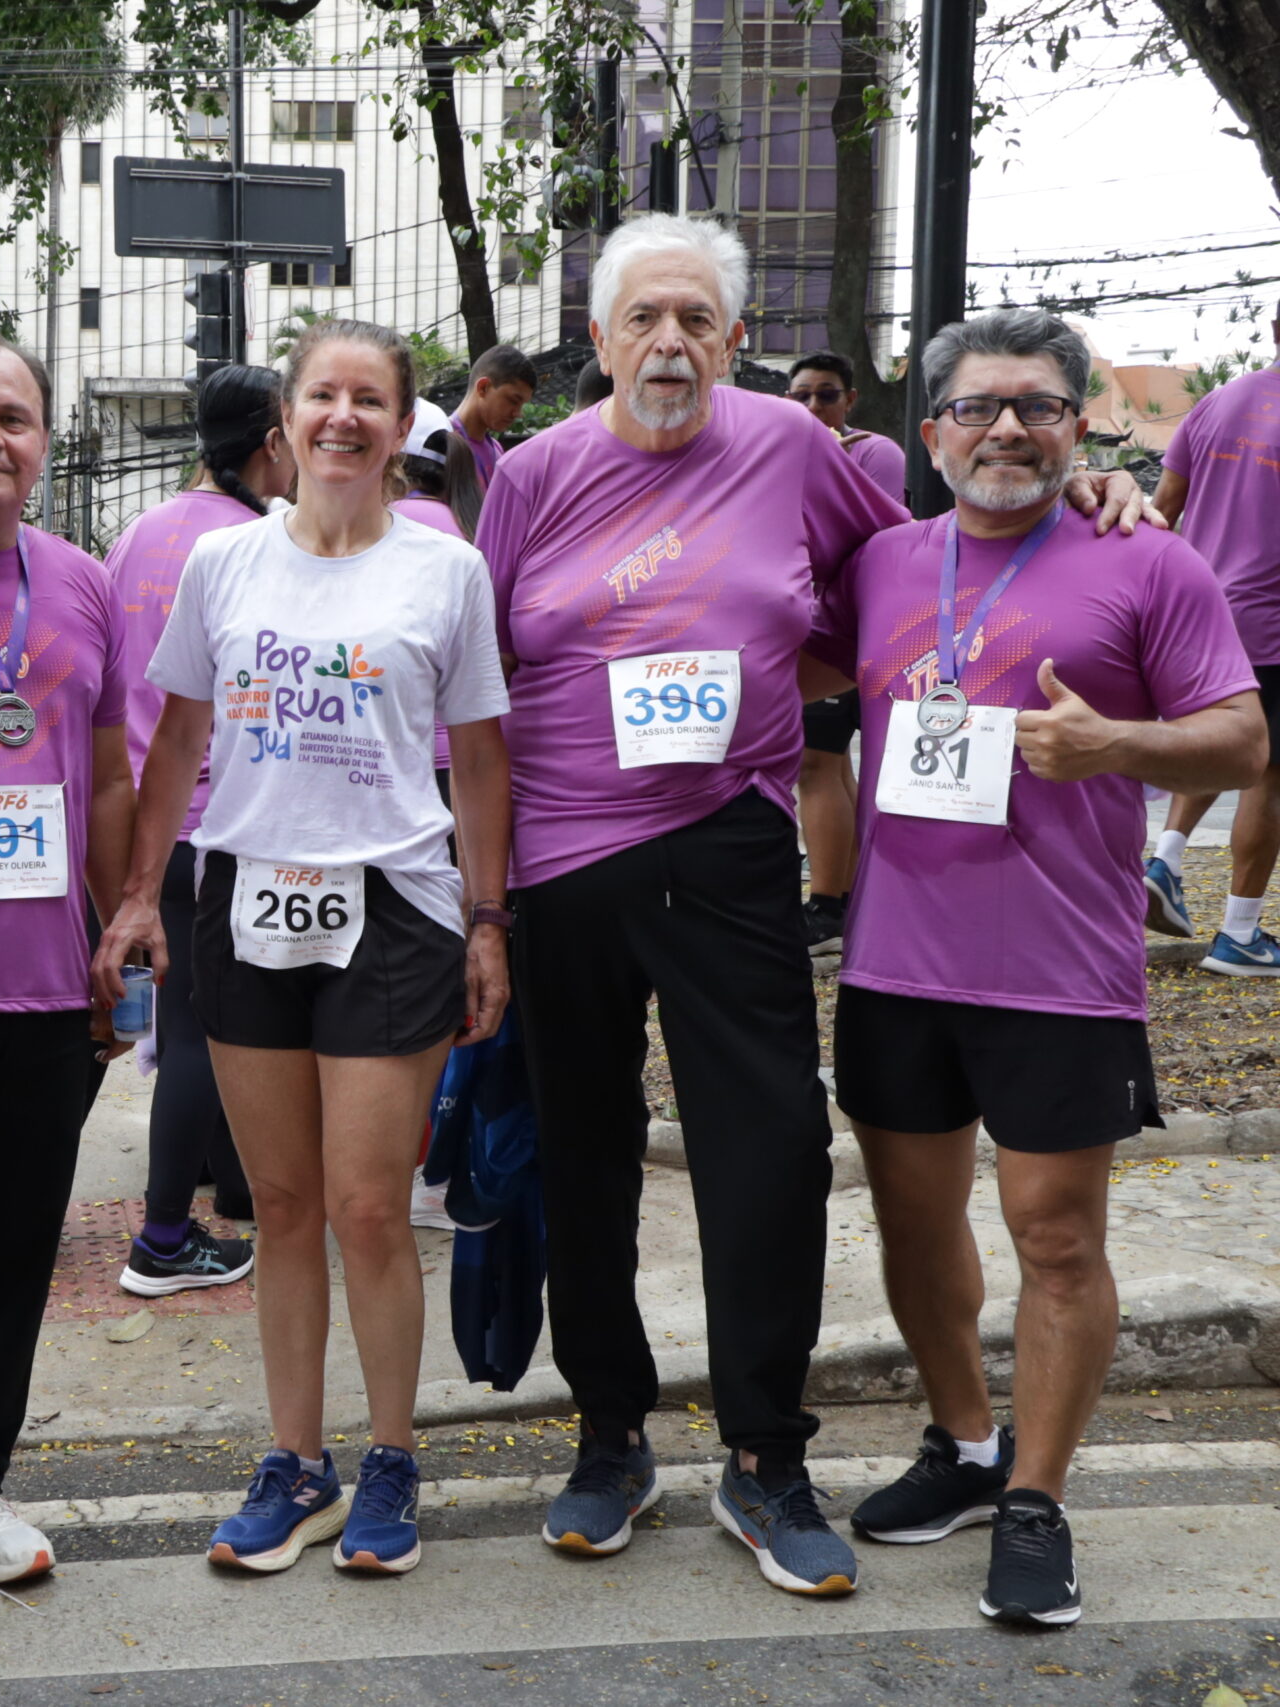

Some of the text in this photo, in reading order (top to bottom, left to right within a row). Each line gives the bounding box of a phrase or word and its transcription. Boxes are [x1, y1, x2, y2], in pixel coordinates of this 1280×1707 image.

[608, 529, 682, 604] TRF6
[911, 649, 938, 671] corrida
[645, 660, 700, 679] TRF6
[624, 682, 727, 726] 396
[300, 732, 338, 742] ATUANDO
[635, 726, 720, 738] CASSIUS DRUMOND
[299, 743, 334, 753] DIREITOS
[336, 746, 352, 755] DAS
[910, 734, 970, 779] 81
[312, 755, 350, 768] SITUAÇÃO
[352, 758, 362, 767] DE
[348, 771, 374, 786] CNJ
[935, 781, 971, 792] SANTOS
[11, 861, 47, 870] OLIVEIRA
[274, 869, 324, 886] TRF6
[252, 890, 348, 933] 266
[266, 933, 333, 943] LUCIANA COSTA
